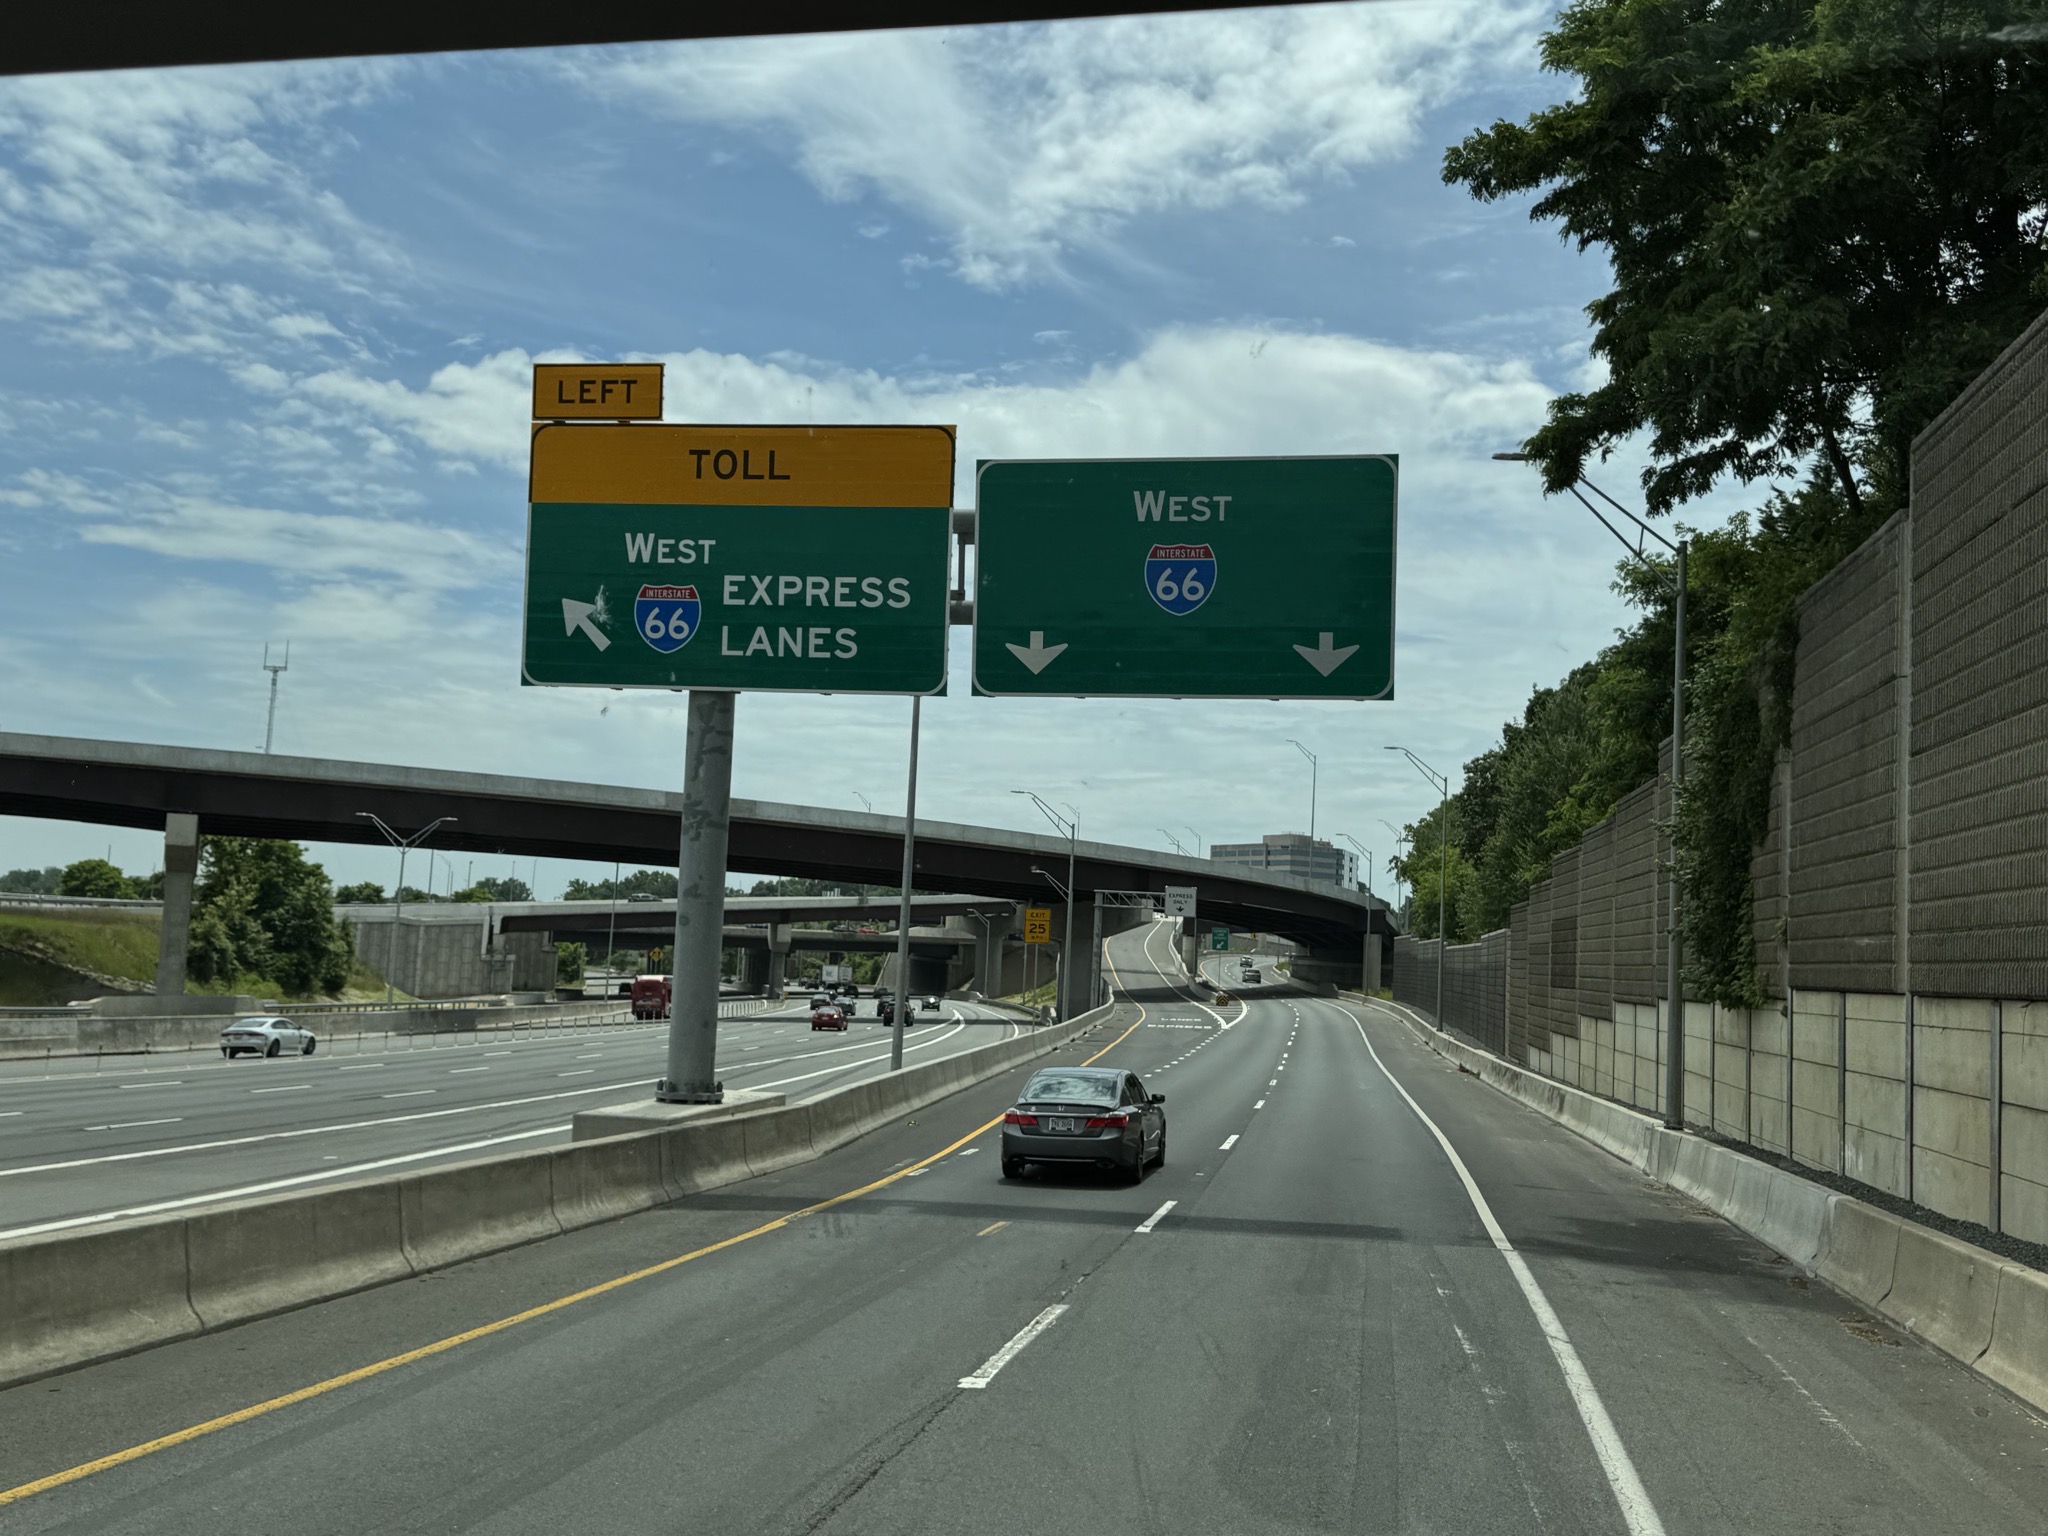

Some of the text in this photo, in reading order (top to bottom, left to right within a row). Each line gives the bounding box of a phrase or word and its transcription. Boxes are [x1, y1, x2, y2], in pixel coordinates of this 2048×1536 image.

[558, 379, 638, 404] LEFT
[688, 449, 791, 480] TOLL
[1133, 490, 1232, 522] WEST
[625, 532, 716, 565] WEST
[1156, 548, 1205, 558] INTERSTATE
[645, 589, 691, 599] INTERSTATE
[723, 574, 911, 609] EXPRESS
[1156, 567, 1205, 601] 66
[645, 607, 690, 640] 66
[721, 625, 858, 659] LANES
[1029, 923, 1046, 934] 25
